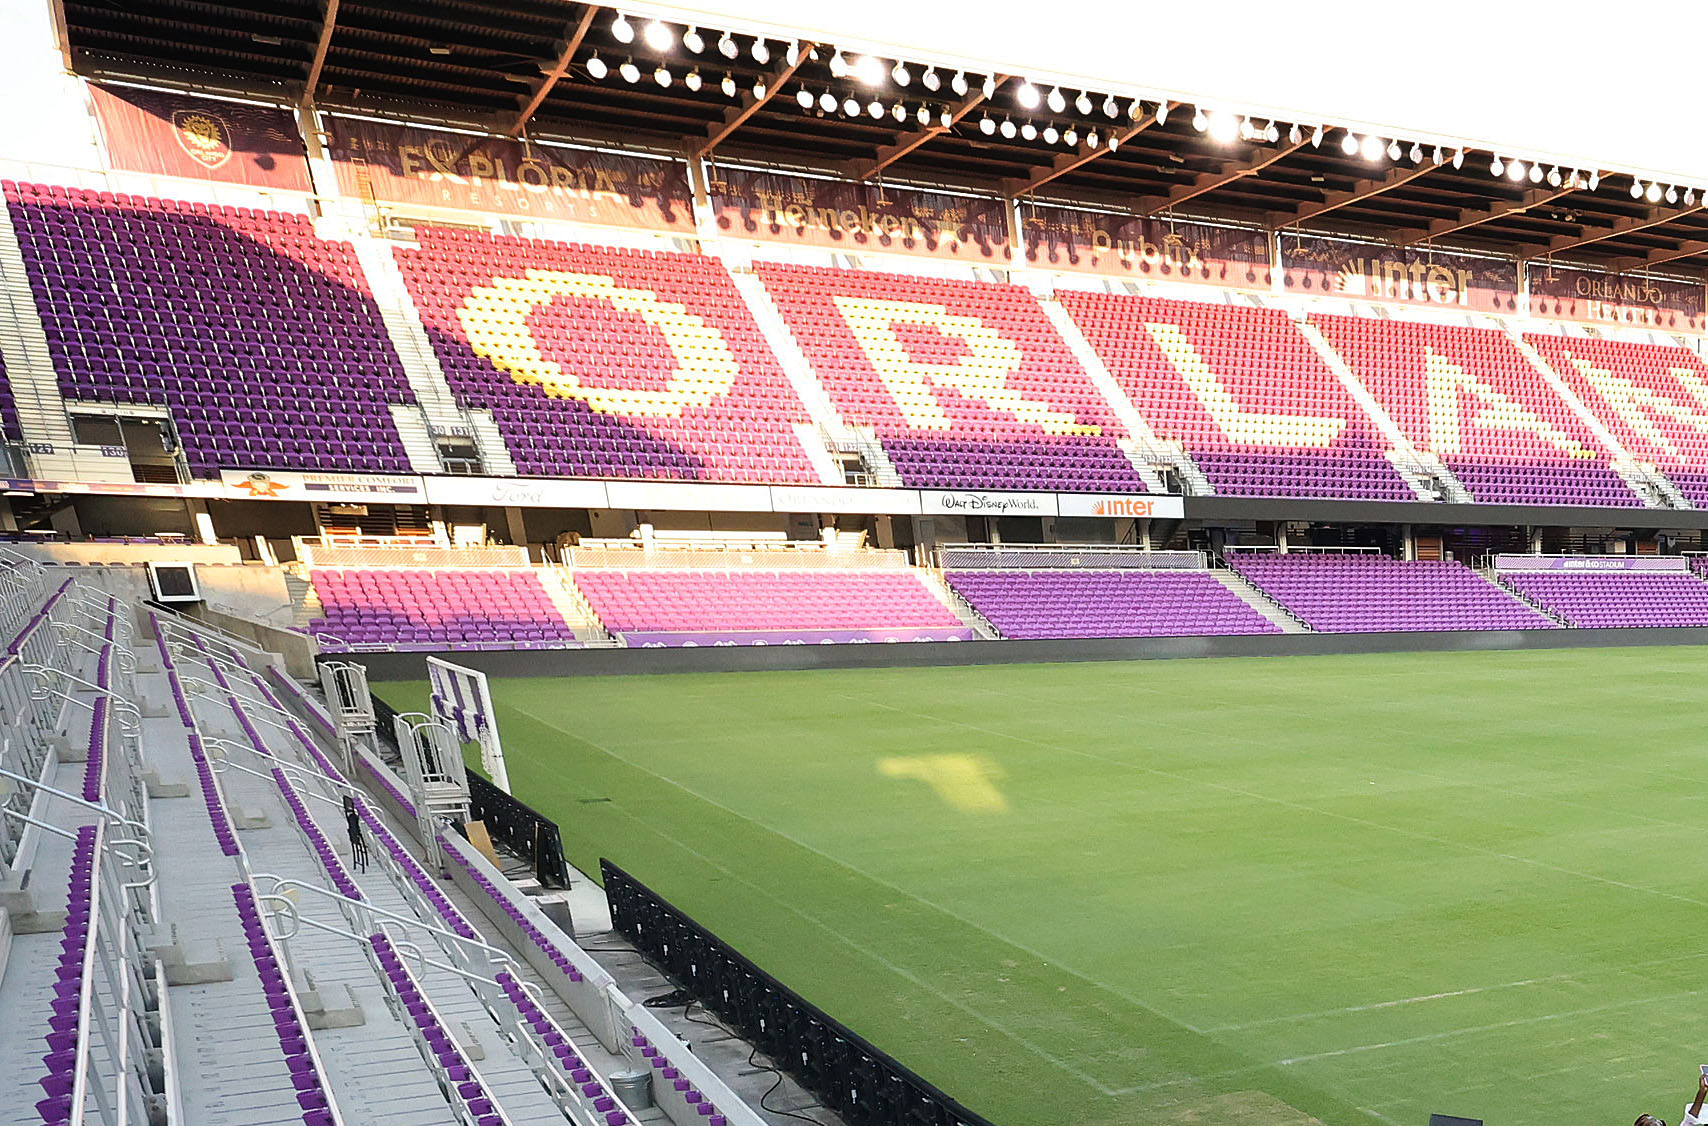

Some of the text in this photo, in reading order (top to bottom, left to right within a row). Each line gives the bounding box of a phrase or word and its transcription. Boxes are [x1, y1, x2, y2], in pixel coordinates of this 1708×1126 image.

[443, 189, 597, 217] RESORTS
[760, 192, 923, 240] Heineken
[1372, 259, 1474, 305] inter
[1576, 276, 1663, 305] ORLANDO
[1586, 301, 1654, 326] HEALTH
[1107, 498, 1154, 515] inter
